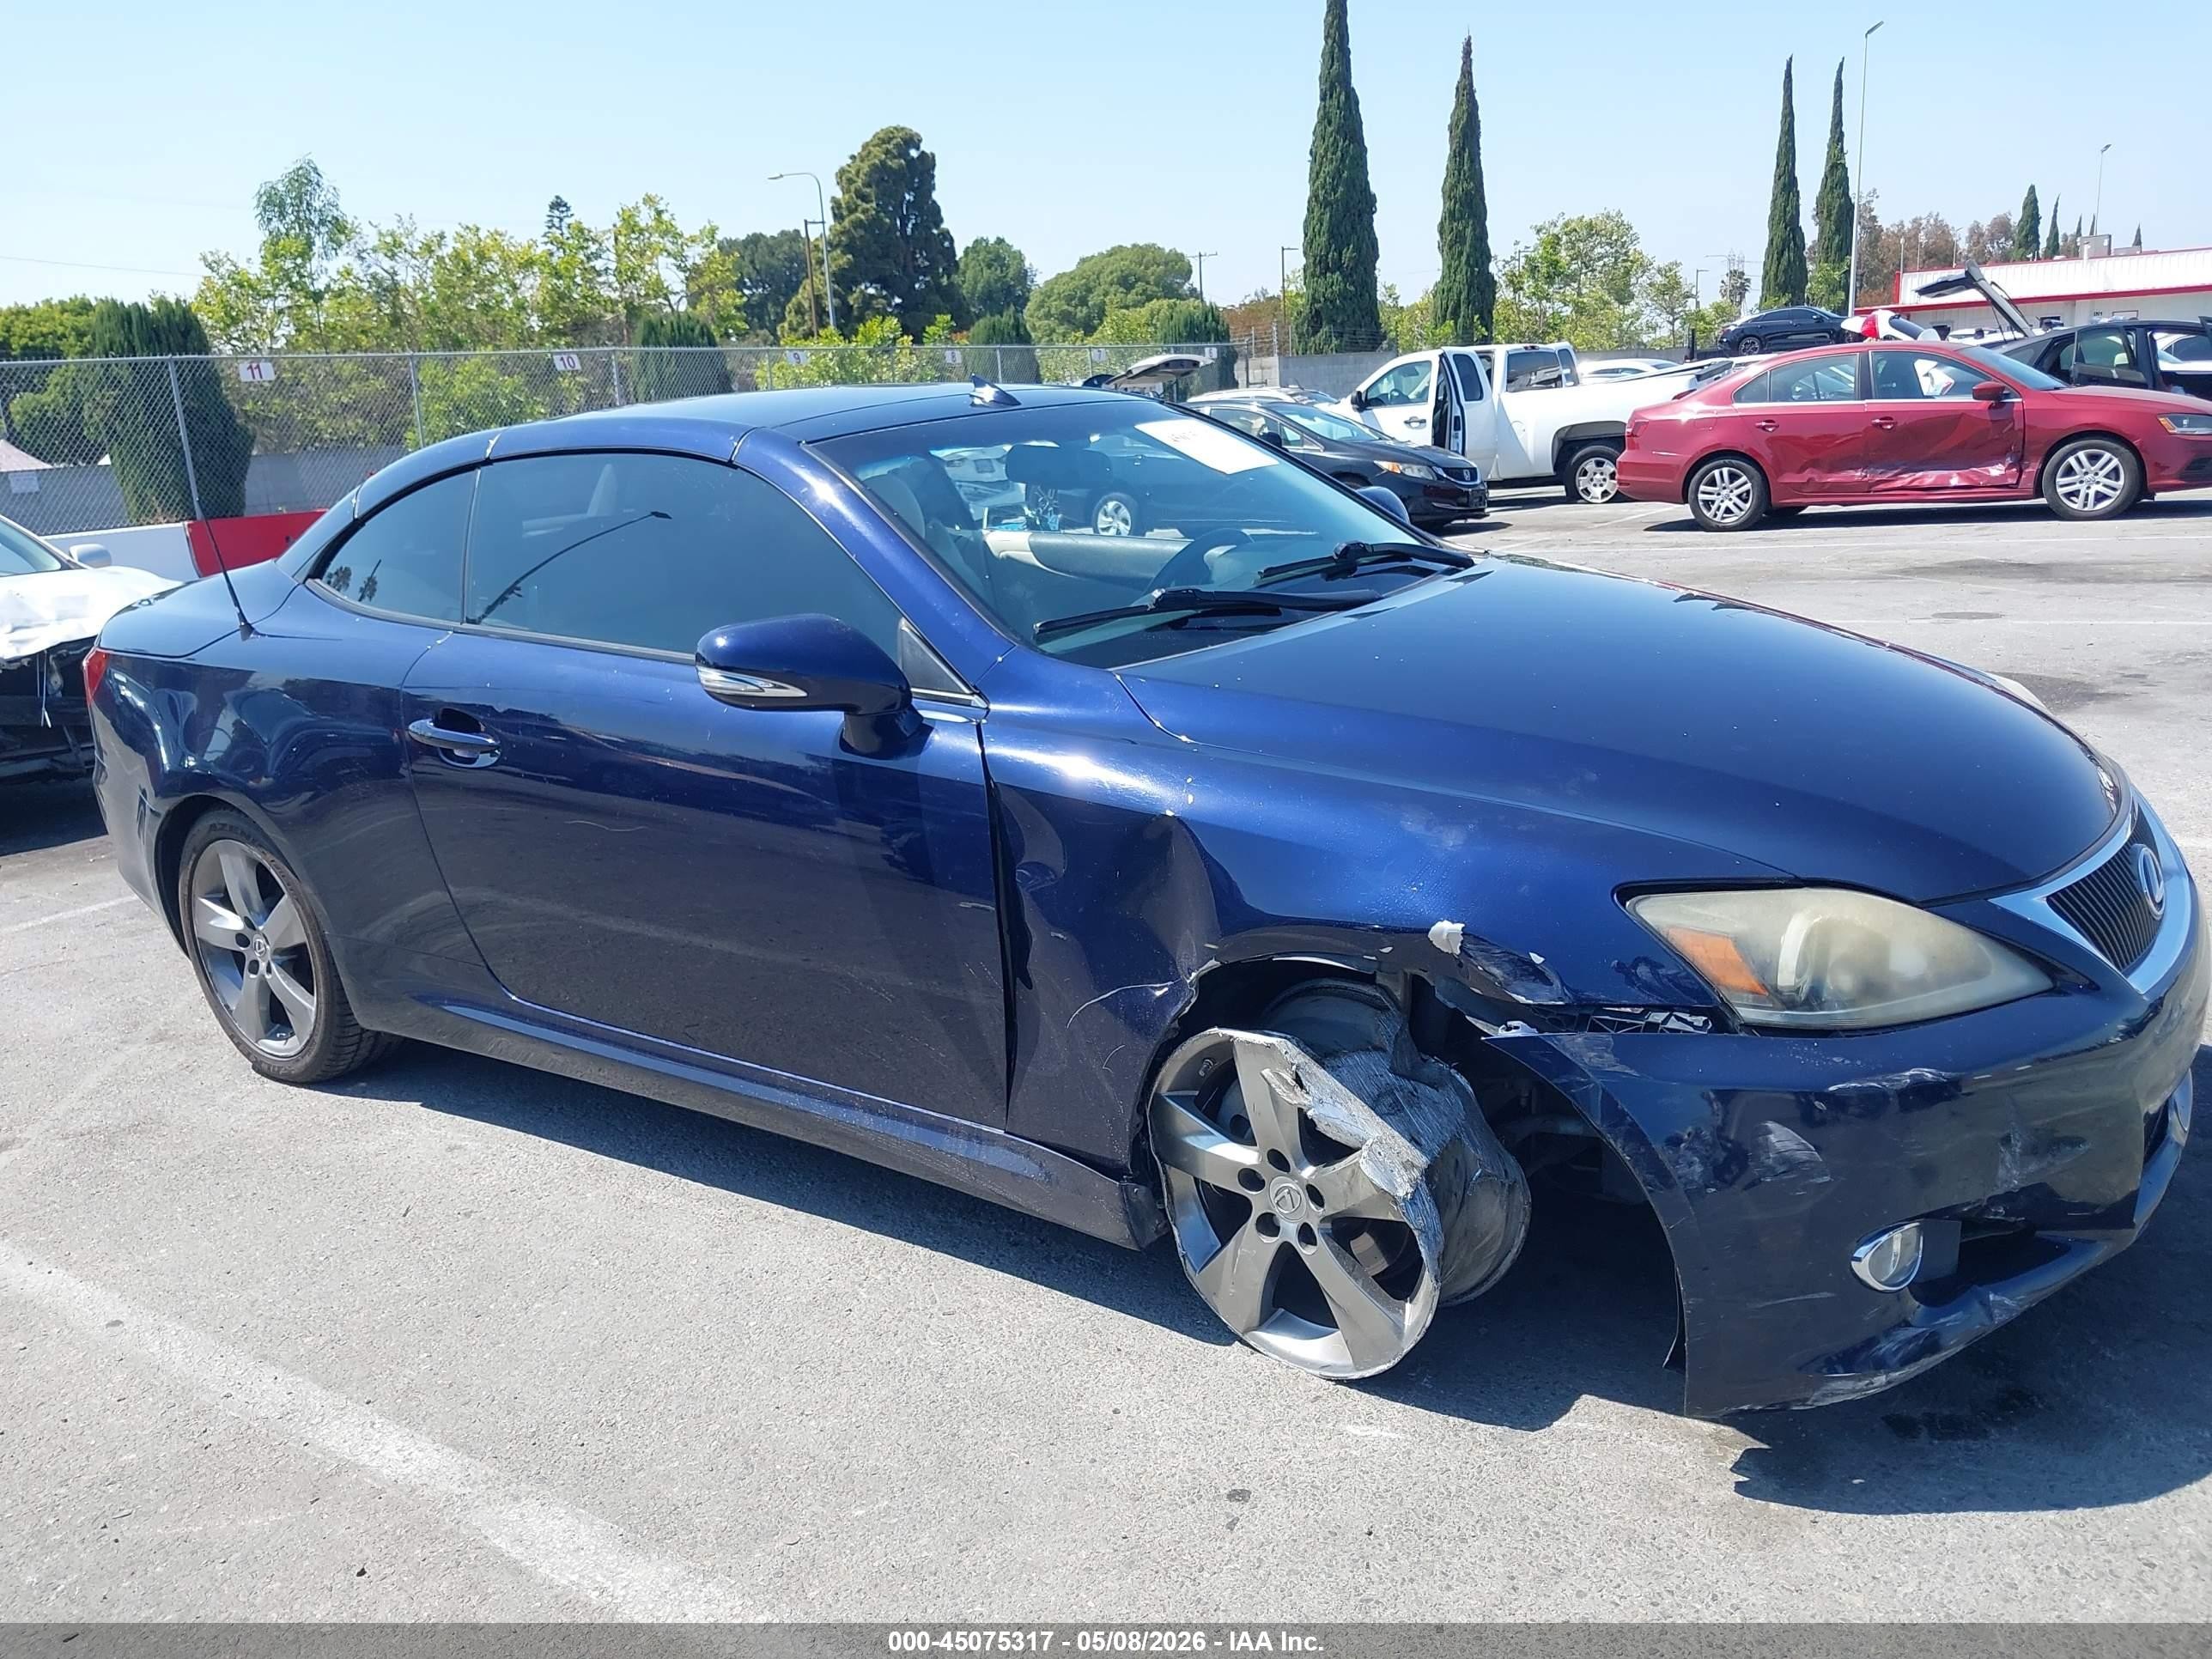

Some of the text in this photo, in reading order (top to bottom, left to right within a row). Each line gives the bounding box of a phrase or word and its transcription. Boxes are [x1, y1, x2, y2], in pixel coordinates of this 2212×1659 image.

[560, 356, 576, 369] 10
[793, 352, 801, 364] 9
[246, 363, 263, 380] 11
